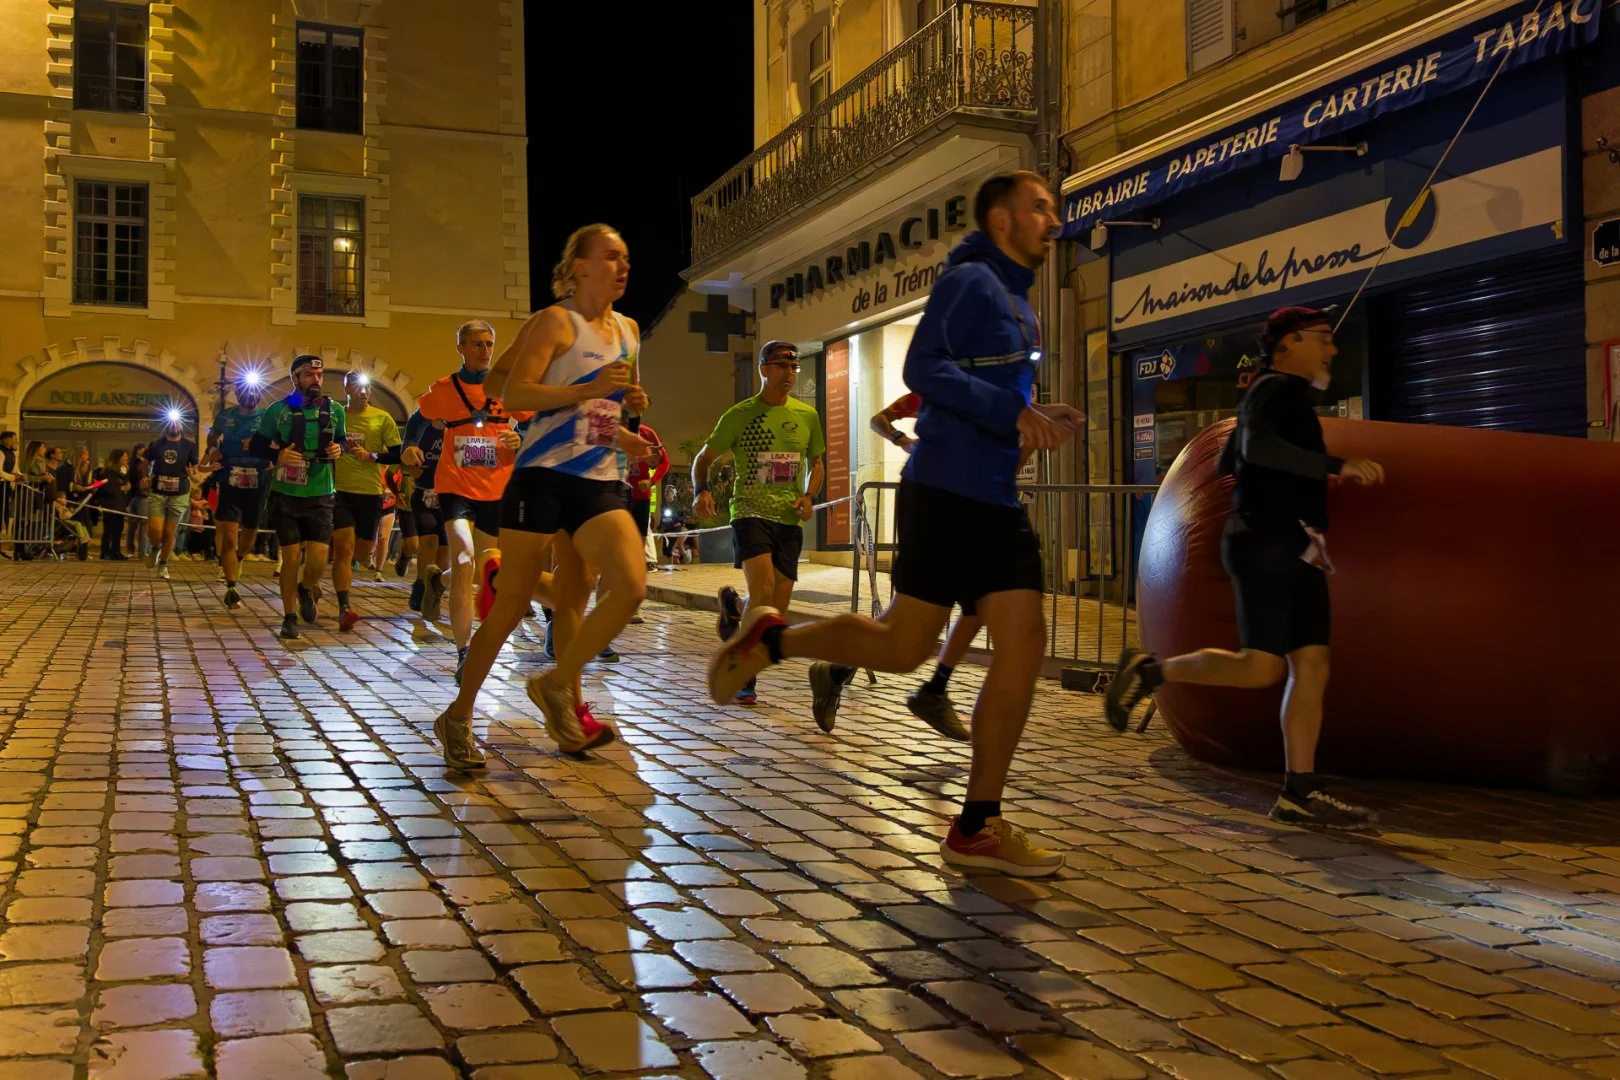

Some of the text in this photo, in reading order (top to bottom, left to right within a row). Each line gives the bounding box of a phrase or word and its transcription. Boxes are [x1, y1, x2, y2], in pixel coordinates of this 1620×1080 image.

[1067, 0, 1593, 223] LIBRAIRIE PAPETERIE CARTERIE TABAC
[770, 196, 967, 309] PHARMACIE
[852, 261, 946, 314] de la Trémo
[1139, 360, 1157, 375] FDJ
[71, 420, 149, 430] LA MAISON DU PAIN
